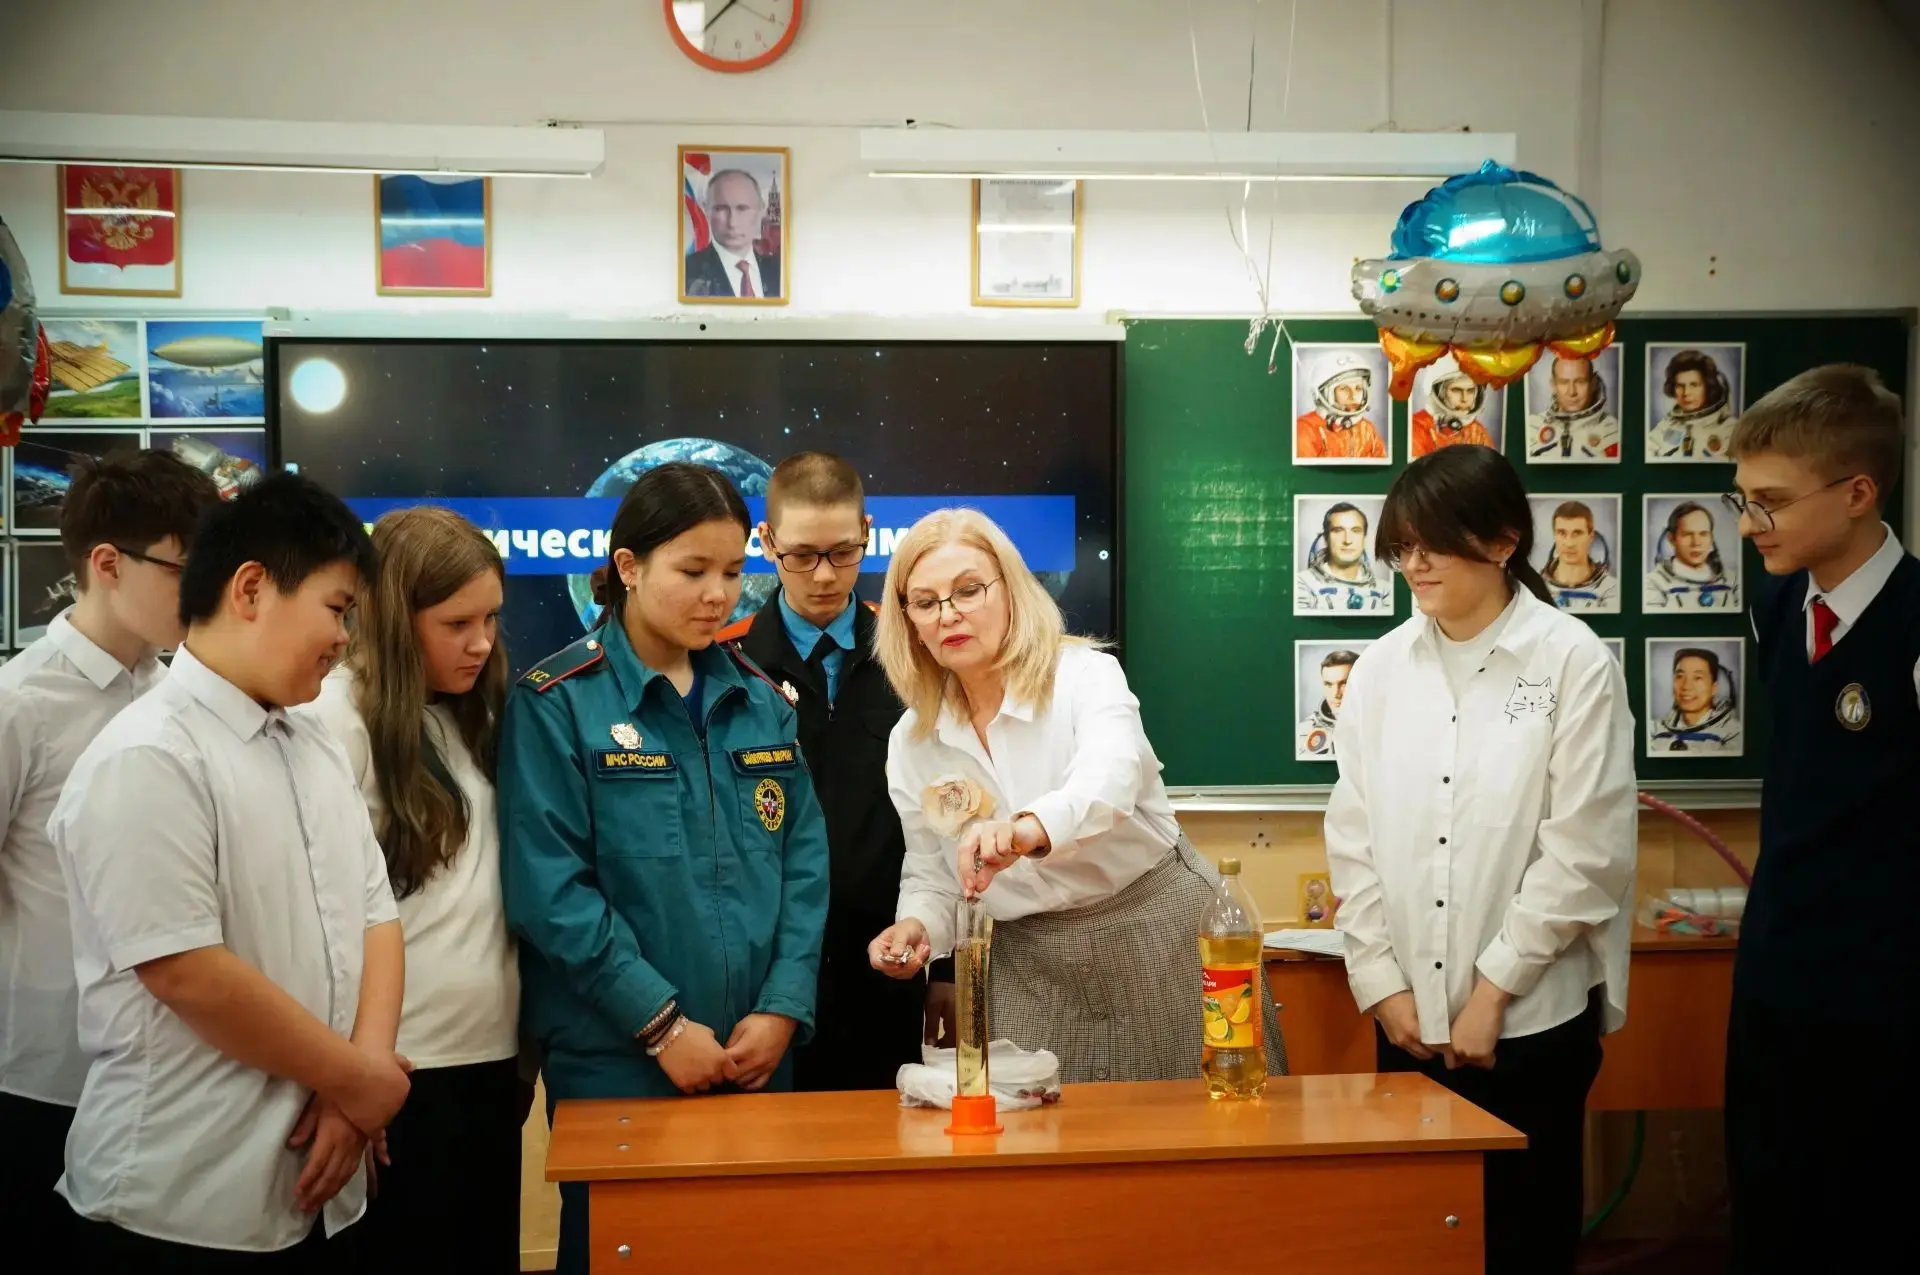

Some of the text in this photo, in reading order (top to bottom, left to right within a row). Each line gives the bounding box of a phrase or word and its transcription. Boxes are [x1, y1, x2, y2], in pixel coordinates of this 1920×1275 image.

[482, 528, 612, 558] ическ
[605, 753, 667, 768] МЧС РОССИИ
